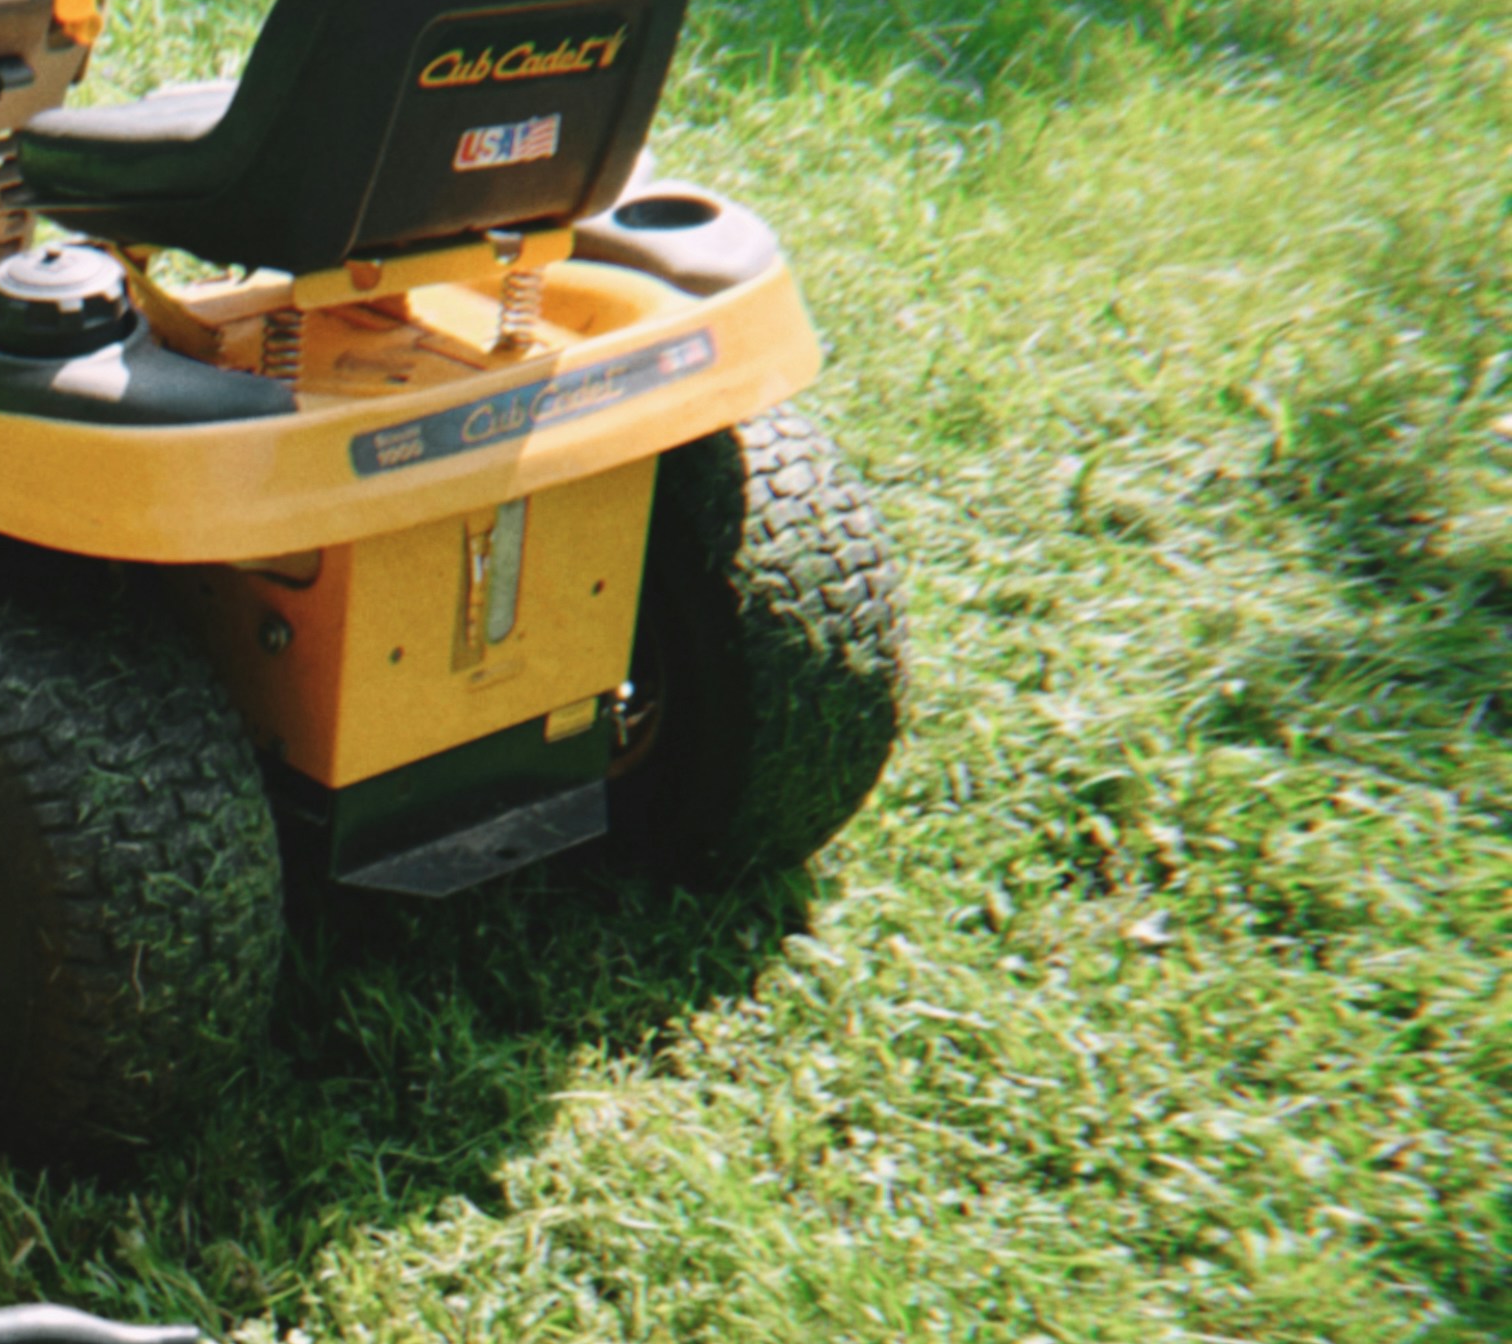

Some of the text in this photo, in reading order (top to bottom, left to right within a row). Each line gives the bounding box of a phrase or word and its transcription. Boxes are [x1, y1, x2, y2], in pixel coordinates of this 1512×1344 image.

[419, 37, 610, 88] Cub Cadet
[460, 126, 517, 163] USA
[462, 396, 525, 444] Cub
[531, 364, 628, 423] Cadet
